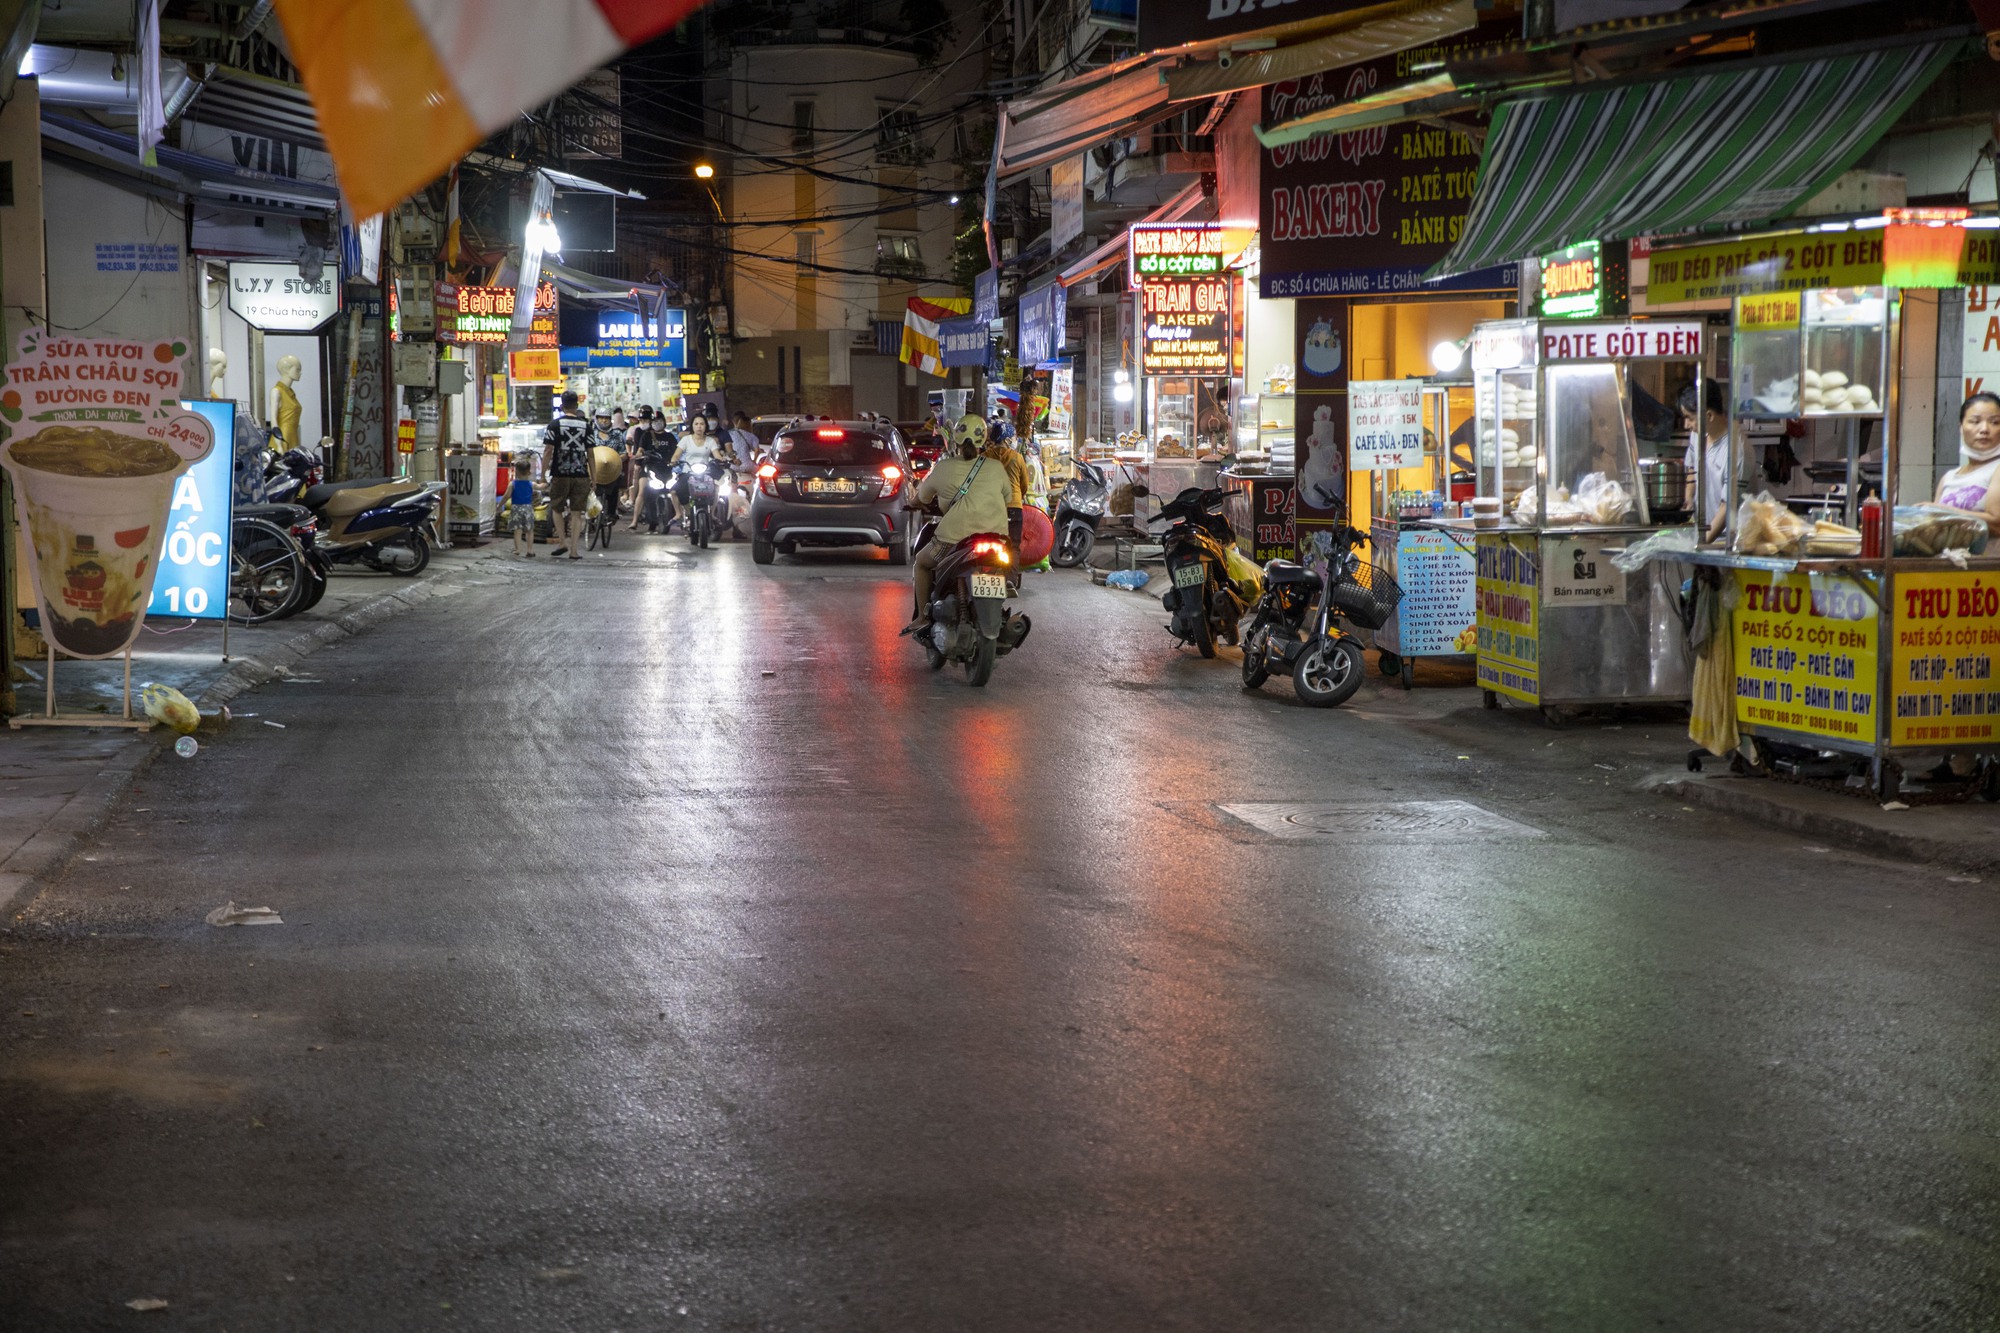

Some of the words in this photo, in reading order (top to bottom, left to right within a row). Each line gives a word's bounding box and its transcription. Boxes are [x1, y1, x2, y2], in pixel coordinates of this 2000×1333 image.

[1402, 125, 1445, 160] BÁNH
[1401, 168, 1441, 203] PATÊ
[1272, 179, 1385, 241] BAKERY
[1401, 210, 1444, 245] BÁNH
[1654, 261, 1678, 284] THU
[1683, 255, 1710, 280] BÉO
[1784, 248, 1795, 270] 2
[1801, 240, 1836, 273] CỘT
[1844, 235, 1883, 266] ĐÈN
[235, 278, 273, 293] L.Y.Y
[284, 279, 331, 294] STORE
[1271, 281, 1288, 295] ĐC:
[1290, 273, 1303, 294] SỐ
[1305, 279, 1311, 292] 4
[1313, 274, 1339, 292] CHÙA
[1341, 273, 1369, 291] HÀNG
[1377, 272, 1390, 290] LÊ
[1393, 270, 1420, 289] CHÂN
[369, 303, 380, 314] 19
[470, 290, 495, 316] CỘT
[1145, 284, 1190, 311] TRAN
[1195, 284, 1226, 311] GIA
[246, 306, 257, 314] 19
[261, 306, 288, 315] Chùa
[292, 306, 318, 318] hàng
[1157, 314, 1214, 325] BAKERY
[1766, 302, 1771, 323] 2
[600, 324, 628, 338] LAN
[1544, 333, 1597, 358] PATE
[1657, 326, 1699, 355] ĐÈN
[46, 340, 88, 358] SỮA
[94, 344, 143, 360] TƯƠI
[10, 361, 70, 384] TRÂN
[76, 361, 137, 382] CHÂU
[142, 368, 178, 390] SỢI
[35, 385, 107, 405] ĐƯỜNG
[112, 391, 150, 406] ĐEN
[53, 411, 77, 422] THƠM
[1402, 414, 1416, 424] 15K
[147, 426, 166, 438] CHỈ
[1355, 430, 1377, 451] CAFÉ
[1379, 430, 1396, 449] SỮA
[1402, 433, 1419, 449] ĐEN
[1373, 454, 1402, 464] 15K
[450, 461, 473, 495] BÉO
[1277, 546, 1282, 557] 6
[974, 587, 1005, 597] 283.74
[977, 576, 1001, 586] 15-B3
[1554, 587, 1572, 596] Bán
[1575, 588, 1601, 596] mang
[1604, 585, 1614, 594] về
[164, 586, 208, 614] 10
[1745, 584, 1803, 614] THU
[1809, 583, 1866, 621] BÉO
[1905, 588, 1951, 619] THU
[1957, 578, 1999, 617] BÉO
[1742, 620, 1769, 638] PATÊ
[1773, 620, 1792, 640] SỐ
[1796, 627, 1803, 642] 2
[1807, 626, 1834, 648] CỘT
[1839, 629, 1866, 648] ĐÈN
[1928, 624, 1943, 646] SỐ
[1946, 630, 1952, 645] 2
[1955, 626, 1978, 649] CỘT
[1981, 625, 2000, 644] ĐÈN
[1750, 645, 1773, 668] PATÊ
[1776, 647, 1797, 674] HỘP
[1808, 652, 1831, 676] PATÊ
[1834, 654, 1854, 680] CÂN
[1737, 674, 1760, 698] BÁNH
[1764, 677, 1777, 701] MÌ
[1780, 682, 1792, 703] TO
[1805, 683, 1830, 709] BÁNH
[1834, 687, 1848, 712] MÌ
[1852, 693, 1872, 715] CAY
[1898, 690, 1918, 717] BÁNH
[1933, 694, 1942, 716] TO
[1952, 689, 1972, 716] BÁNH
